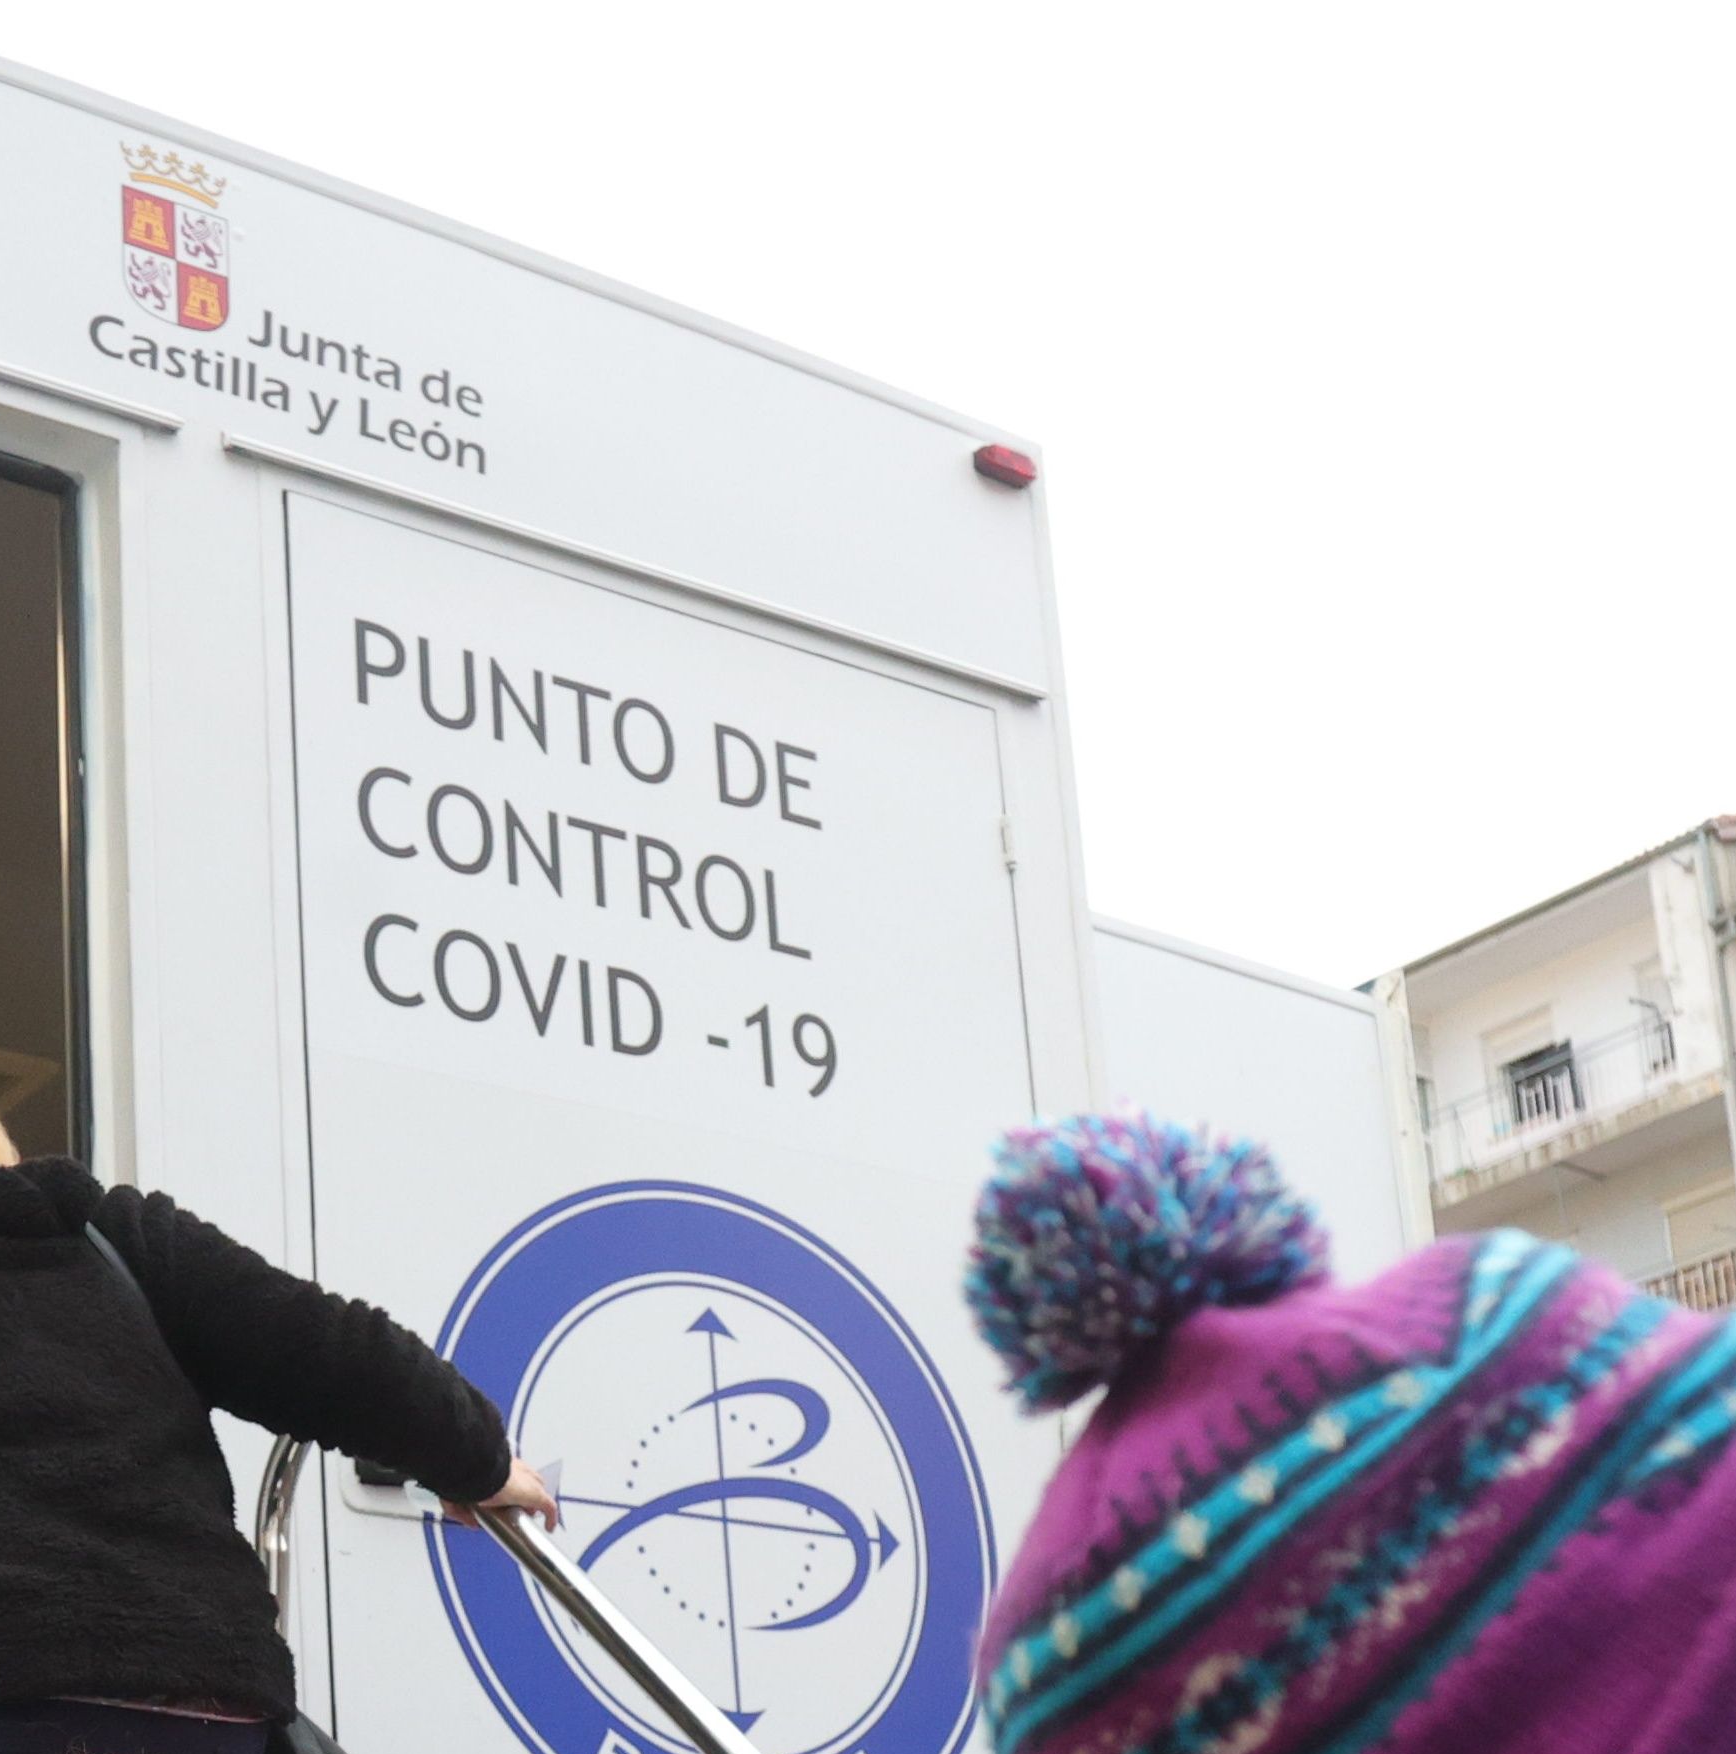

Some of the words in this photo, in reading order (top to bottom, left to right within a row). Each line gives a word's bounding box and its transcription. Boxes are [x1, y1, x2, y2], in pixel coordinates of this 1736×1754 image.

[87, 313, 291, 413] Castilla
[306, 389, 340, 435] y
[358, 397, 488, 476] León
[247, 309, 402, 392] Junta
[419, 369, 484, 418] de
[354, 617, 675, 785] PUNTO
[713, 722, 823, 831] DE
[357, 766, 812, 961] CONTROL
[363, 913, 664, 1057] COVID
[706, 1003, 838, 1099] -19
